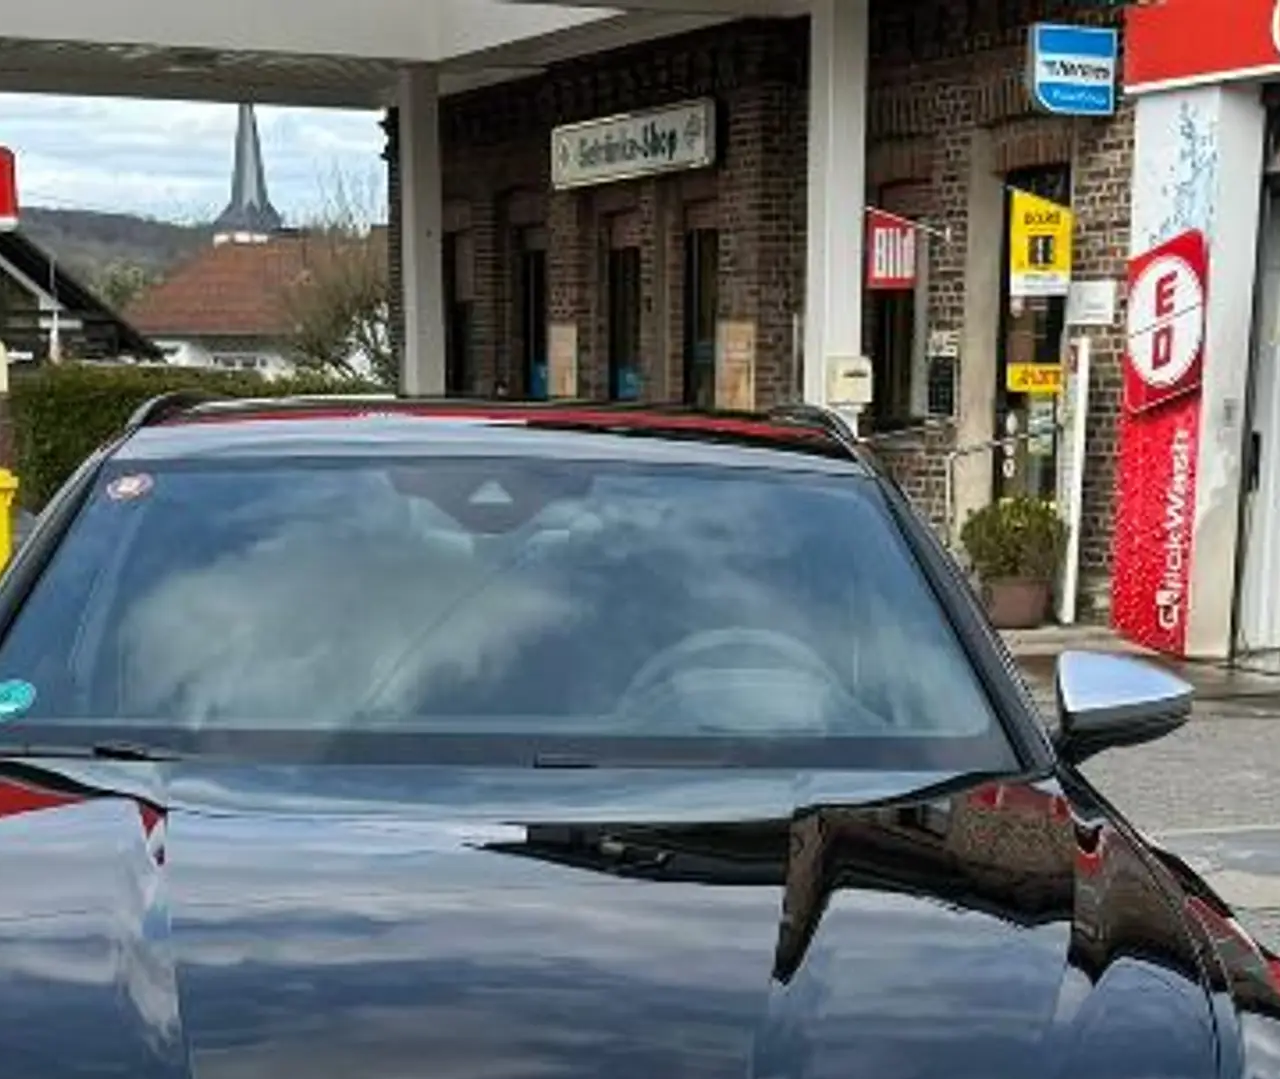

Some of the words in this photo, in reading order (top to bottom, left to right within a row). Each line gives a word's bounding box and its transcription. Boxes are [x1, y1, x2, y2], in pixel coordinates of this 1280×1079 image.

[874, 227, 915, 279] Bild
[1155, 270, 1177, 318] E
[1152, 326, 1175, 371] D
